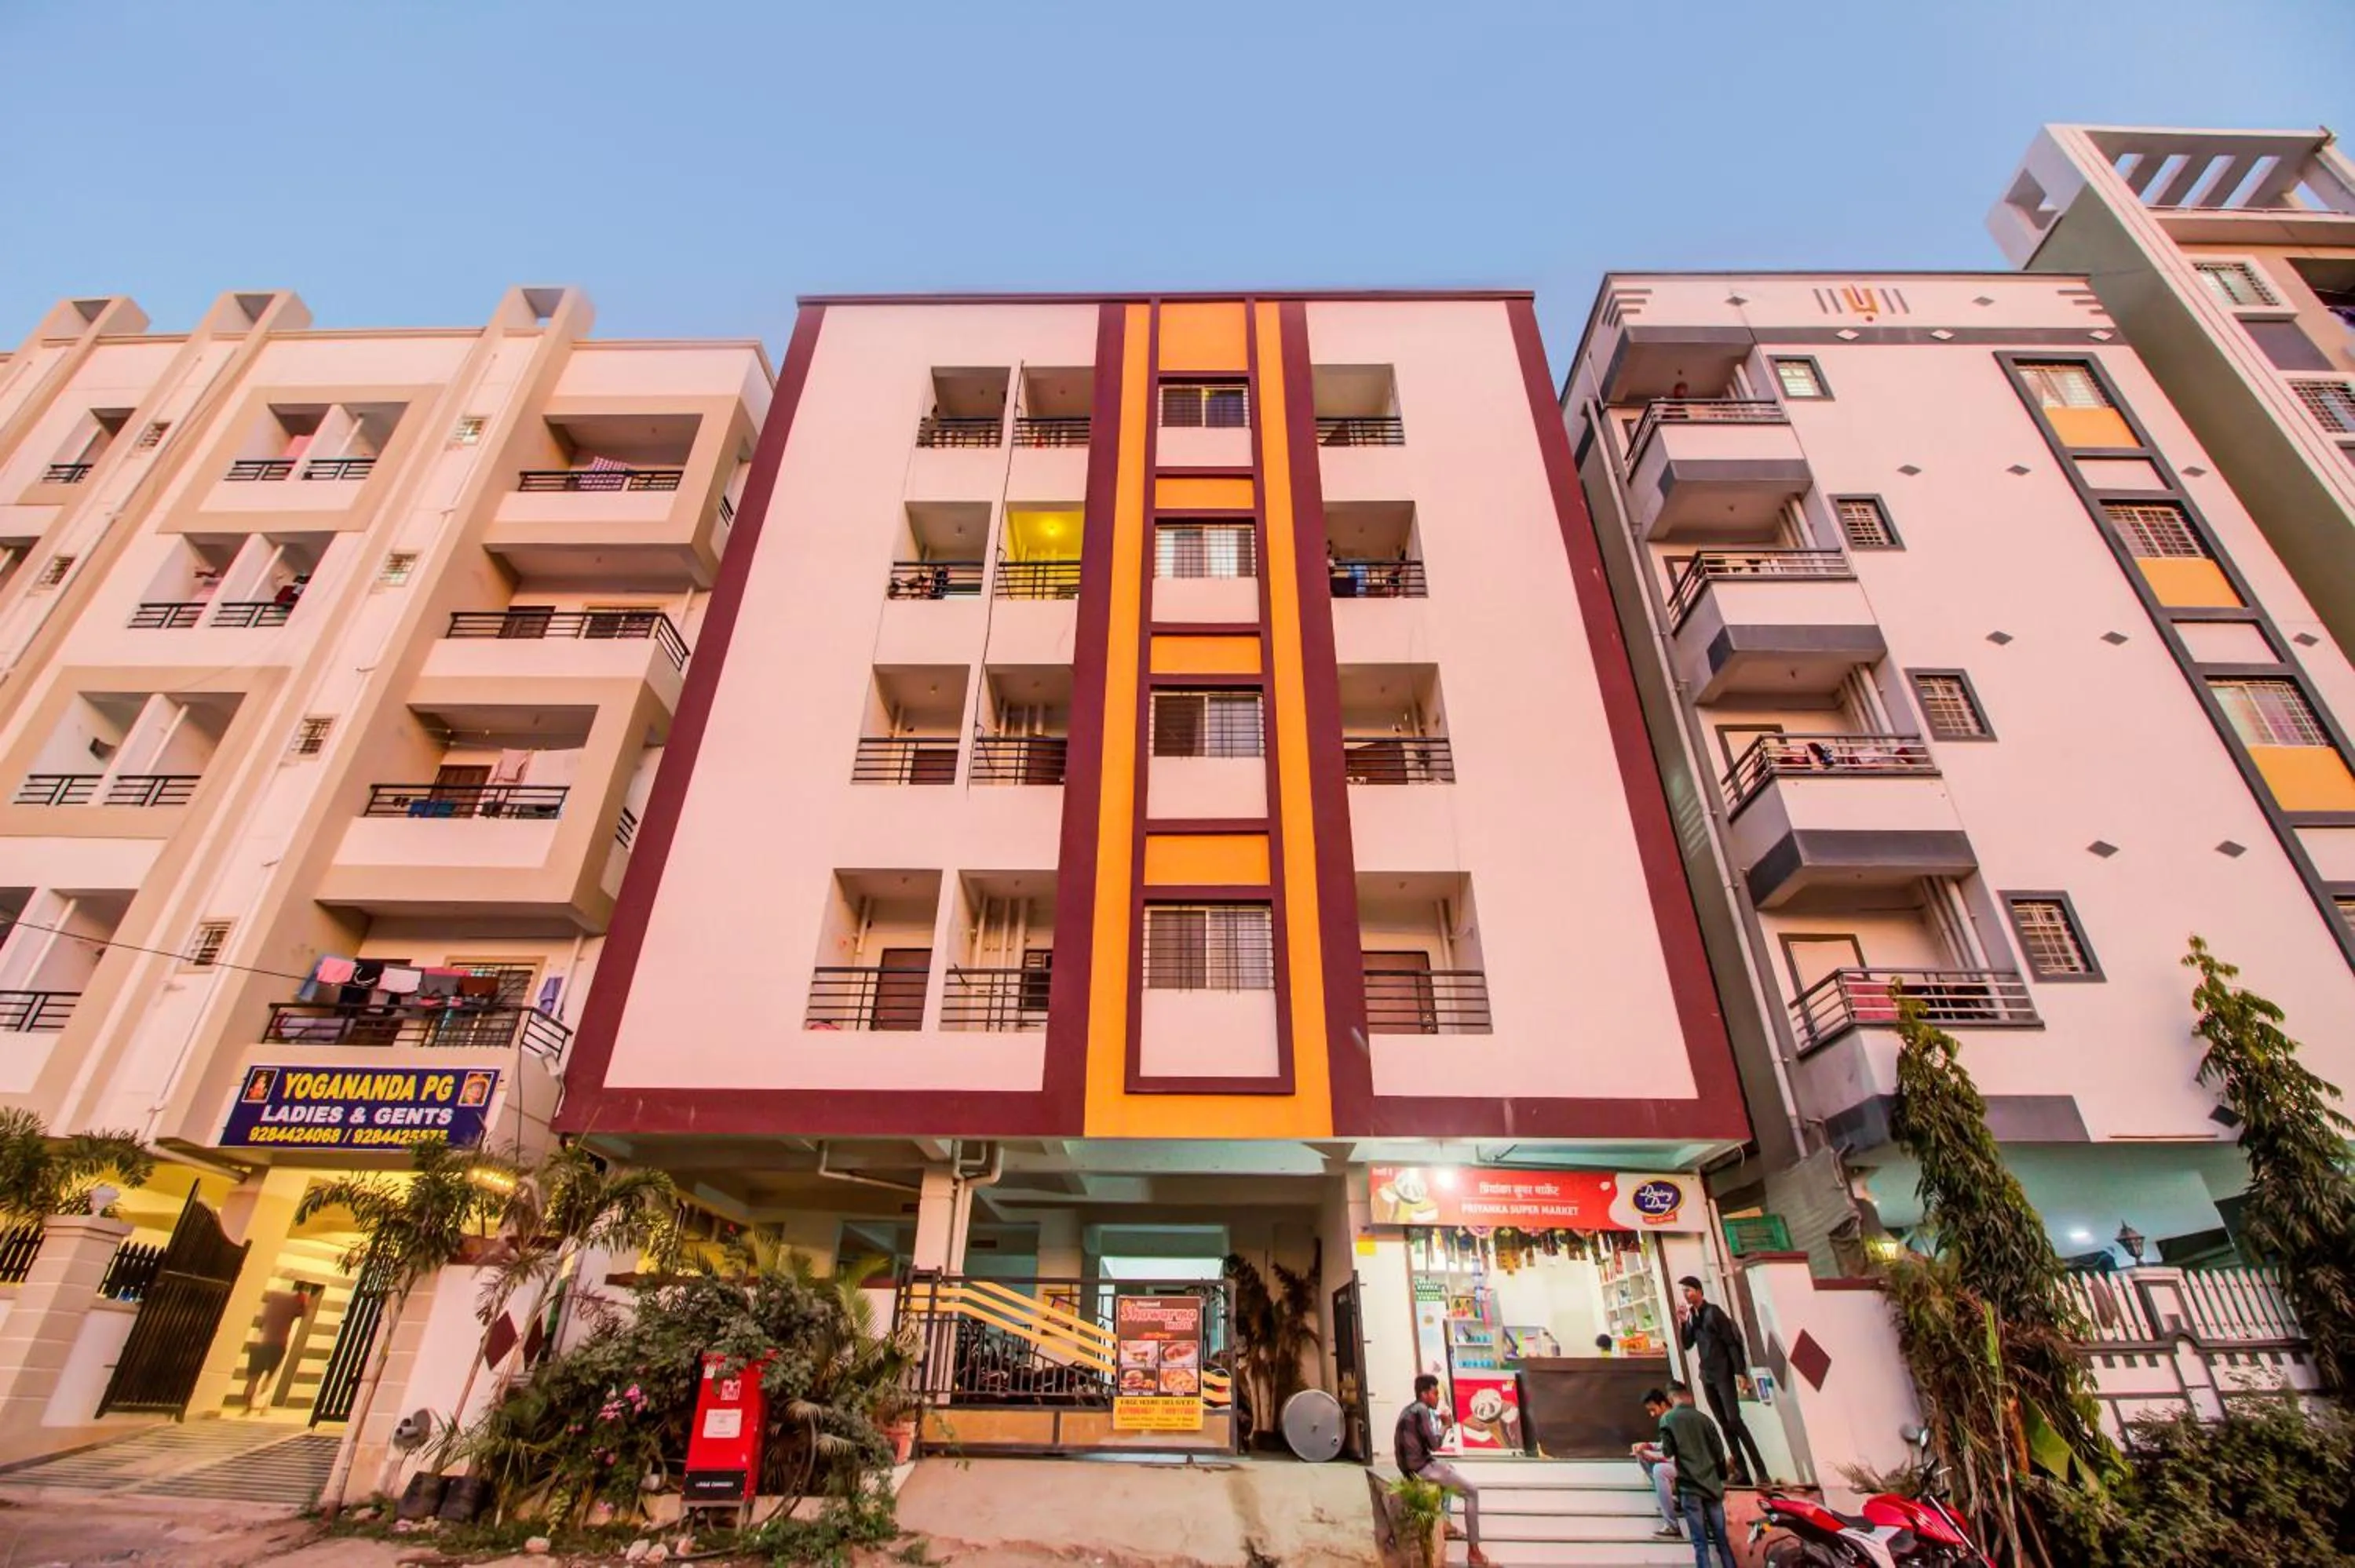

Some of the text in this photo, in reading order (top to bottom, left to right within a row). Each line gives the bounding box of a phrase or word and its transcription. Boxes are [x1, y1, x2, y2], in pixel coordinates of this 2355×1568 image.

[282, 1072, 455, 1101] YOGANANDA PG
[261, 1105, 454, 1125] LADIES & GENTS
[1639, 1184, 1674, 1202] Dairy
[1461, 1203, 1579, 1216] PRIYANKA SUPER MARKET
[1645, 1197, 1671, 1215] Day
